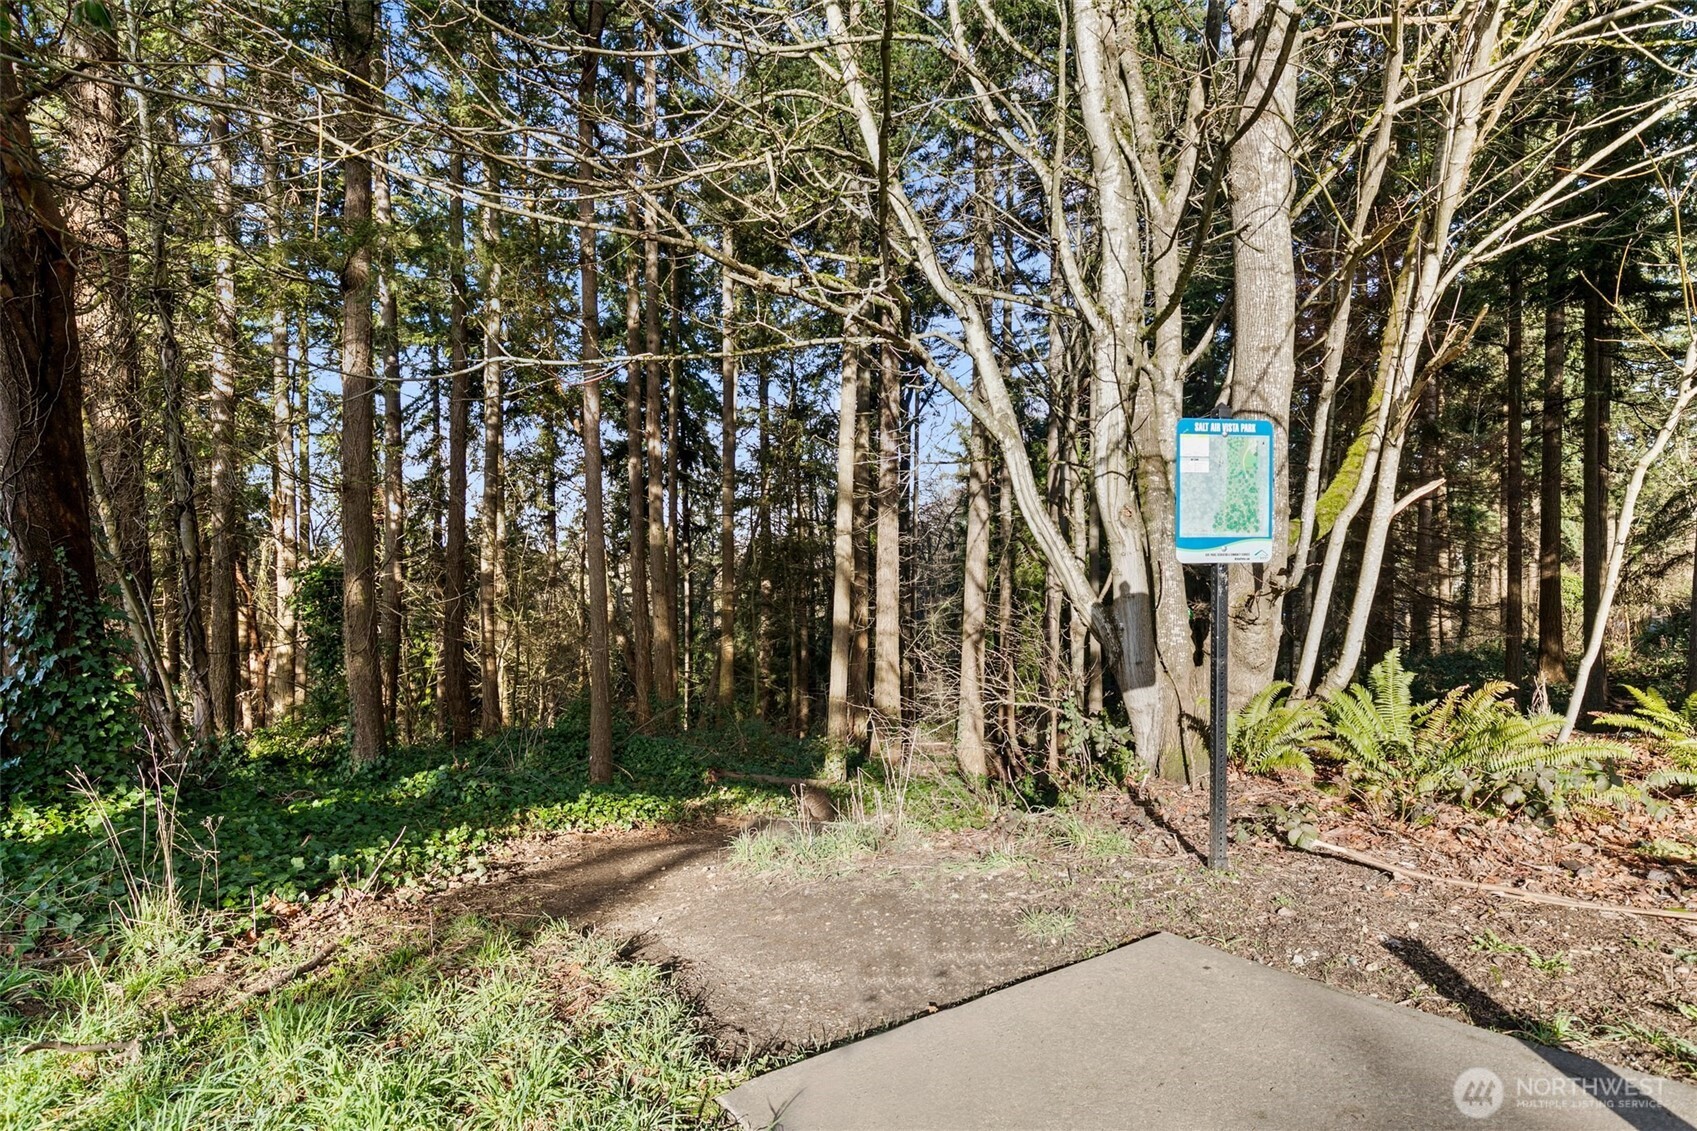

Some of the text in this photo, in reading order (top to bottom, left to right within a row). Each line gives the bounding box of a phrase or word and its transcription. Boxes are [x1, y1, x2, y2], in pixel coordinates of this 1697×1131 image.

[1194, 422, 1257, 433] SALT AIR VISTA PARK
